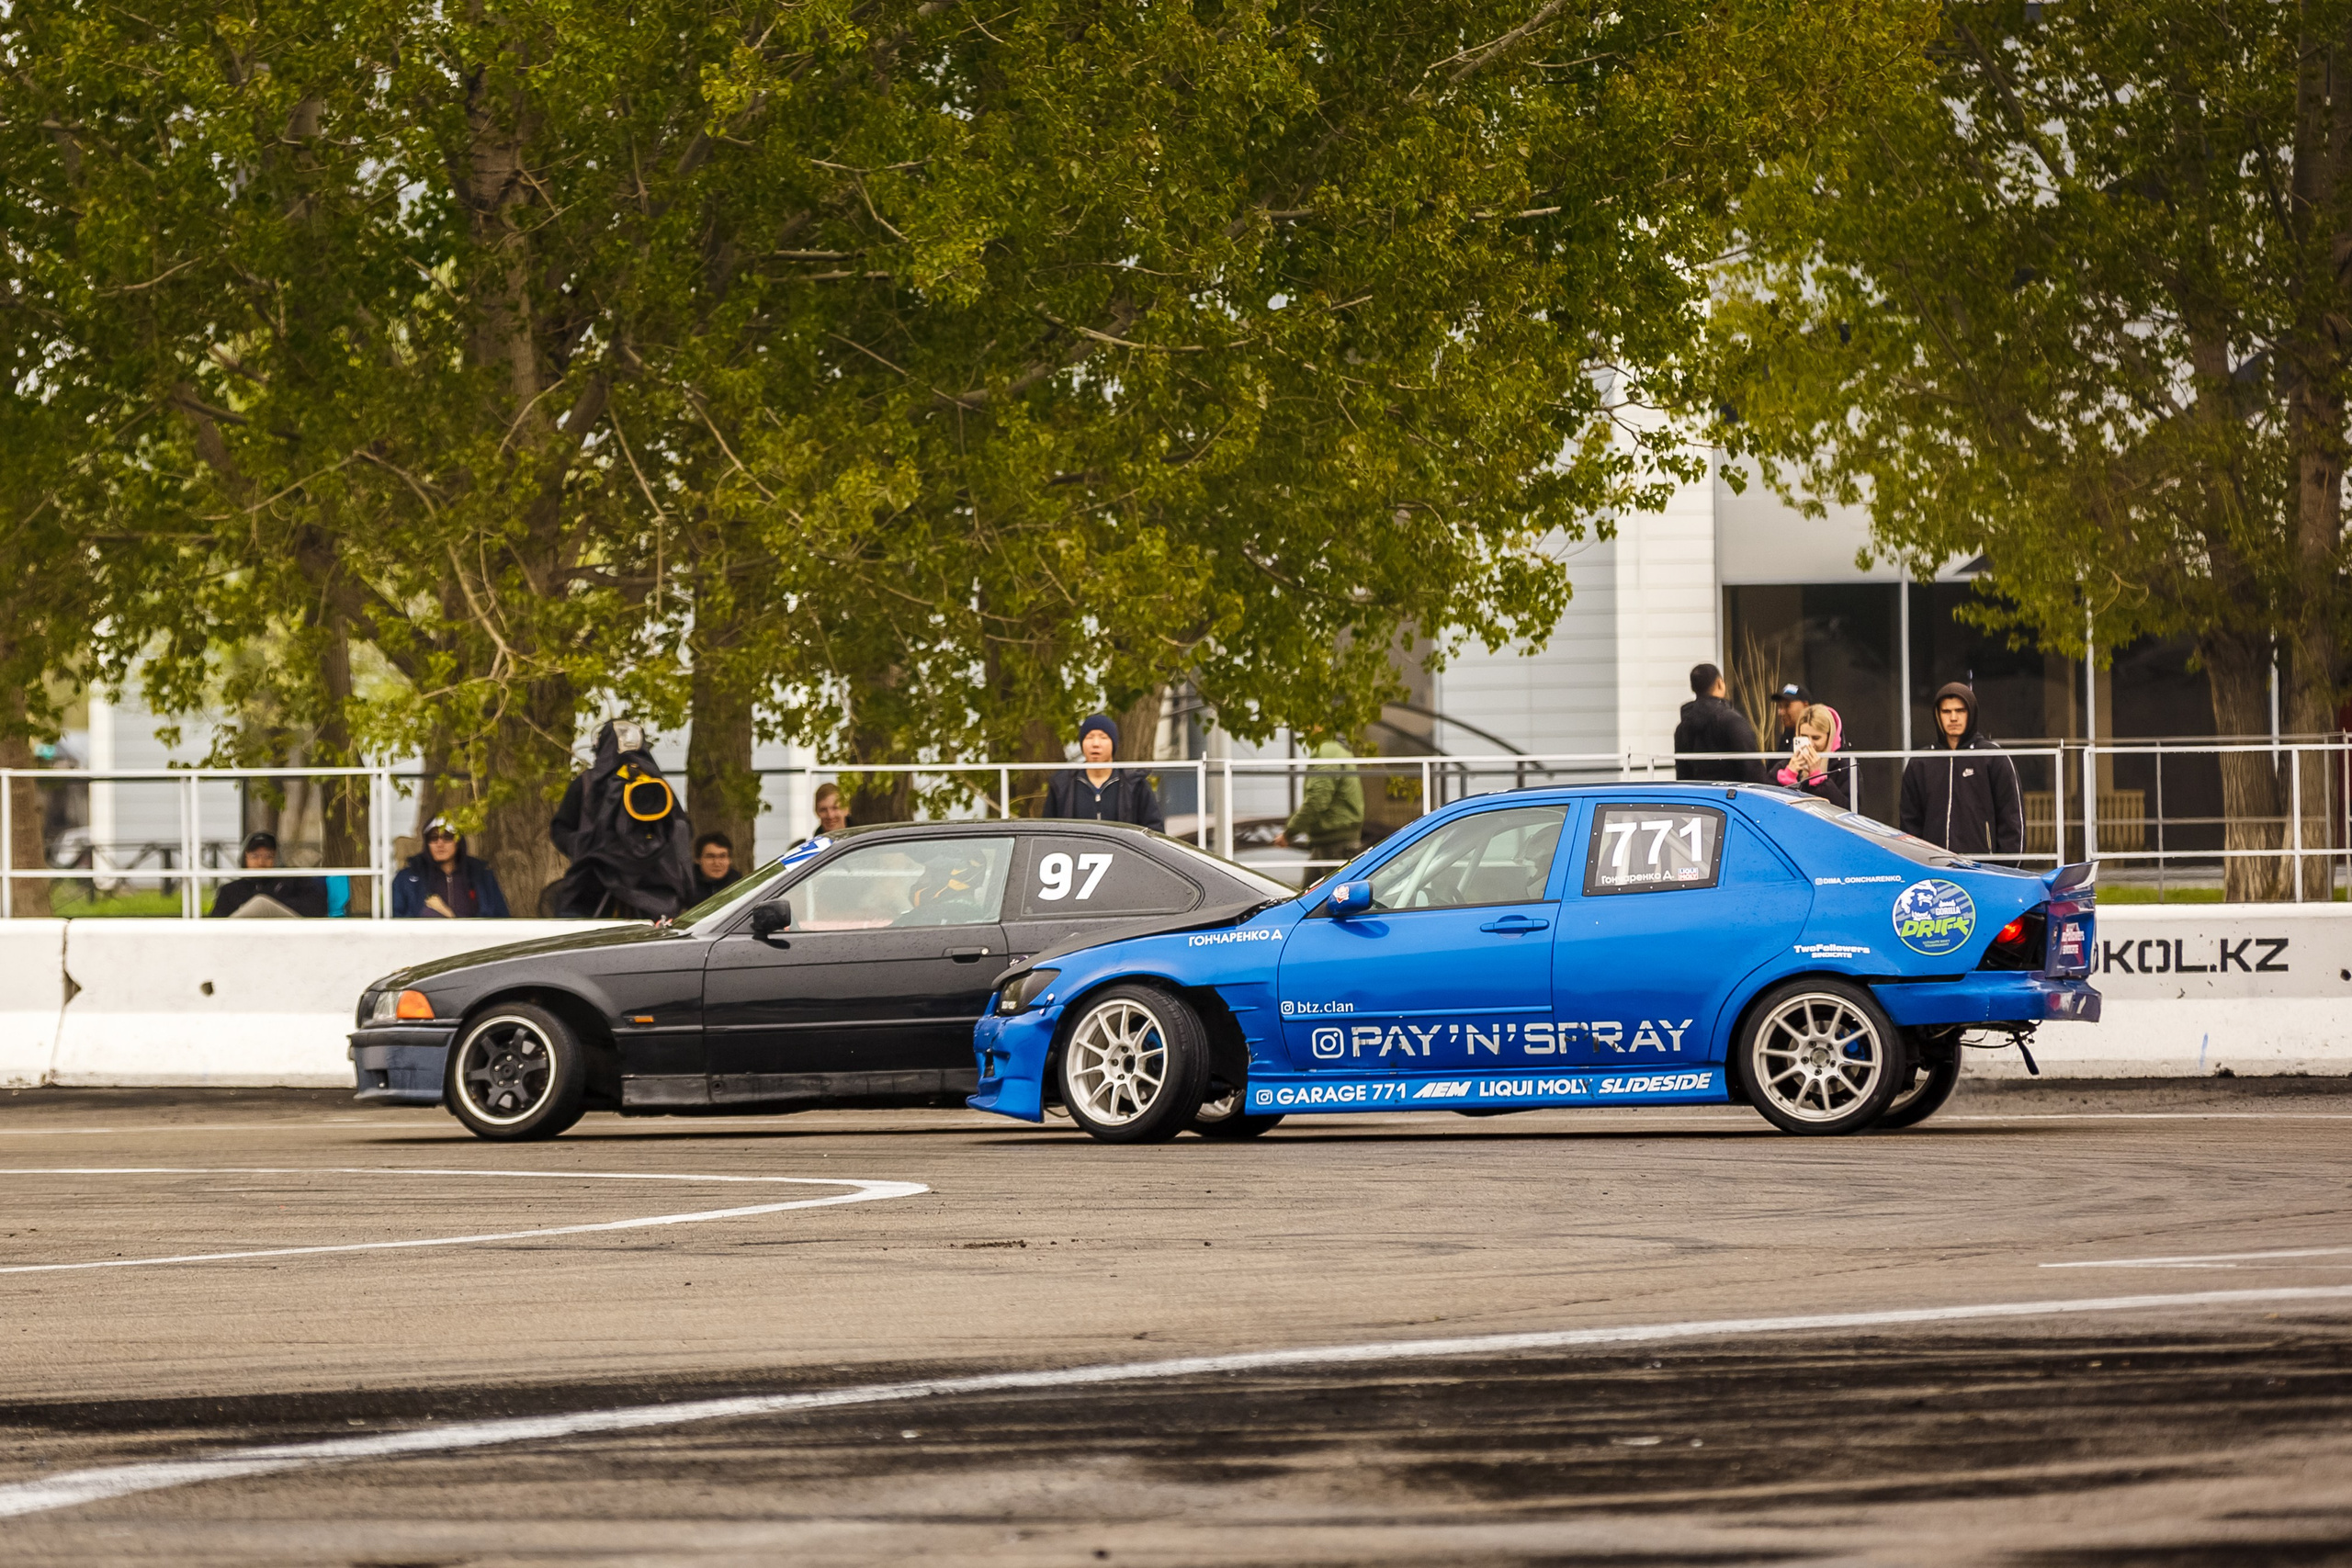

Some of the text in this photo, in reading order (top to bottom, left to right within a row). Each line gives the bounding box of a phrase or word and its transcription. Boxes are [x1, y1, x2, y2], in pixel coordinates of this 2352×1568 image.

[1605, 817, 1702, 867] 771
[1037, 852, 1114, 901] 97
[1601, 872, 1662, 885] Гончаренко
[1189, 929, 1283, 947] ГОНЧАРЕНКО Д
[1901, 917, 1970, 938] DRIFT
[1793, 943, 1871, 954] TwoFollowers
[2095, 938, 2289, 974] KOL.KZ
[1297, 1001, 1353, 1014] btz.clan
[1276, 1072, 1713, 1105] GARAGE 771 AEM LIQUI MOLY SLIDESIDE
